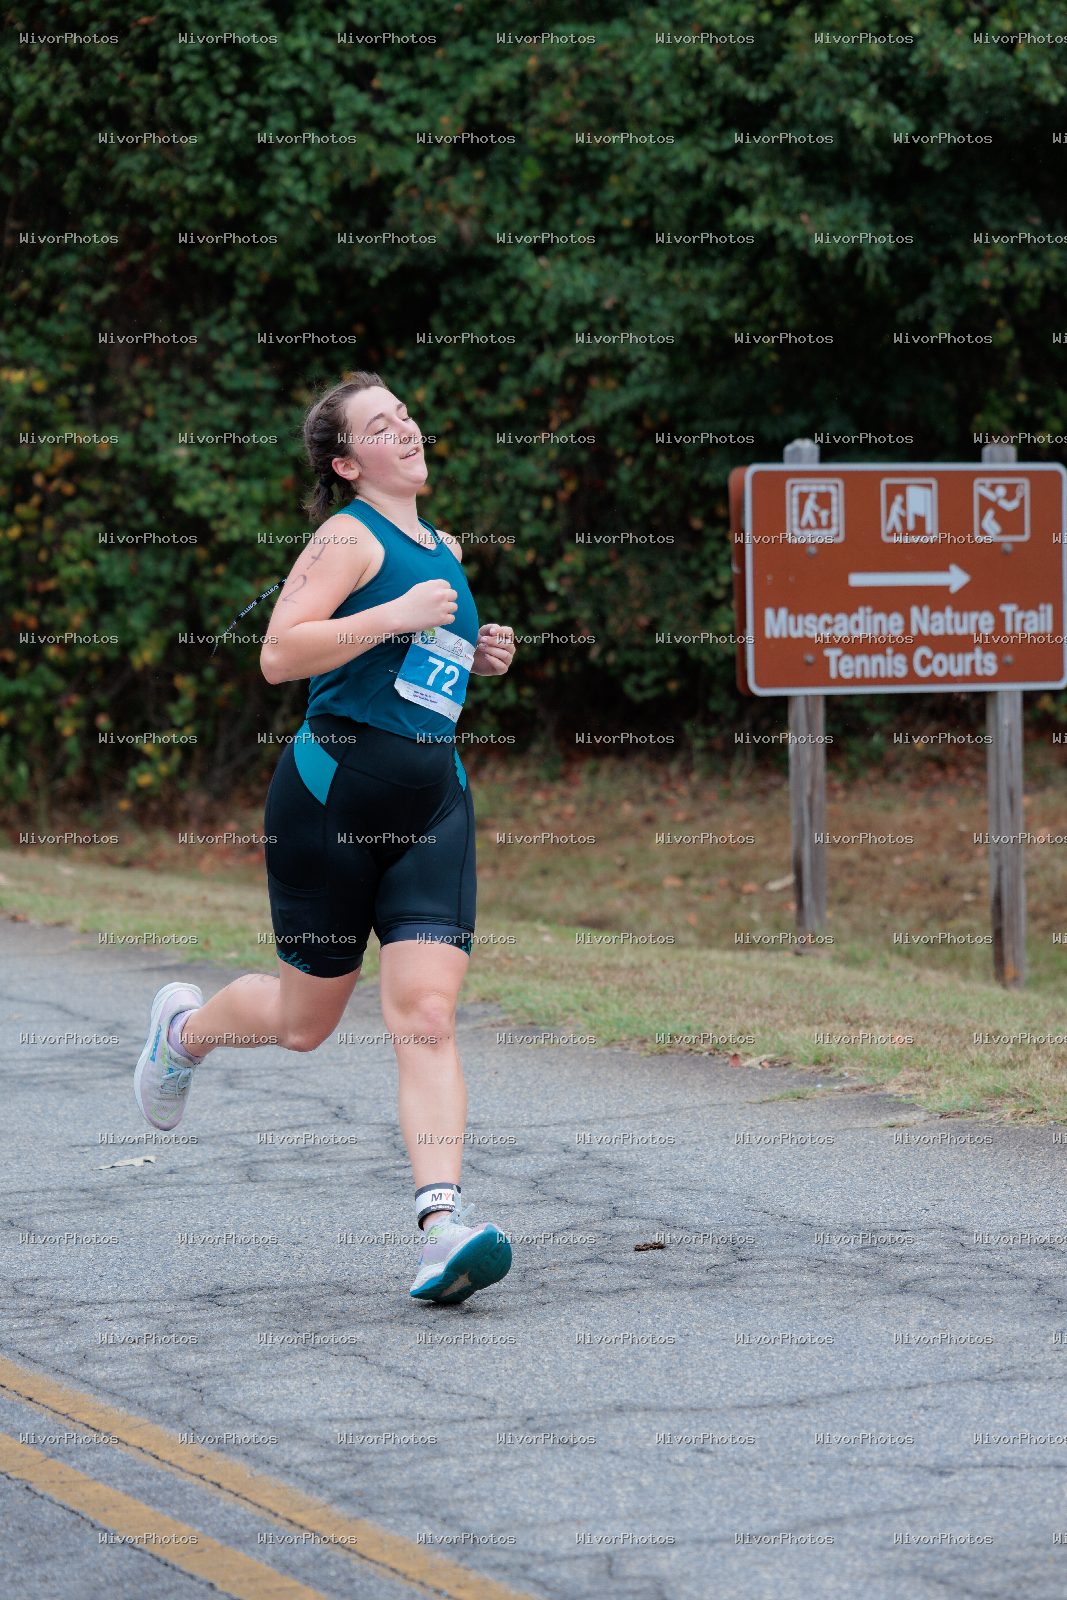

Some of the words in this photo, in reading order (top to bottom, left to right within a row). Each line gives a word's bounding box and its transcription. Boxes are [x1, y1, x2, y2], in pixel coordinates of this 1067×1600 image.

[764, 607, 905, 638] Muscadine
[910, 605, 995, 636] Nature
[999, 603, 1053, 634] Trail
[428, 656, 460, 696] 72
[824, 647, 908, 679] Tennis
[912, 646, 998, 677] Courts
